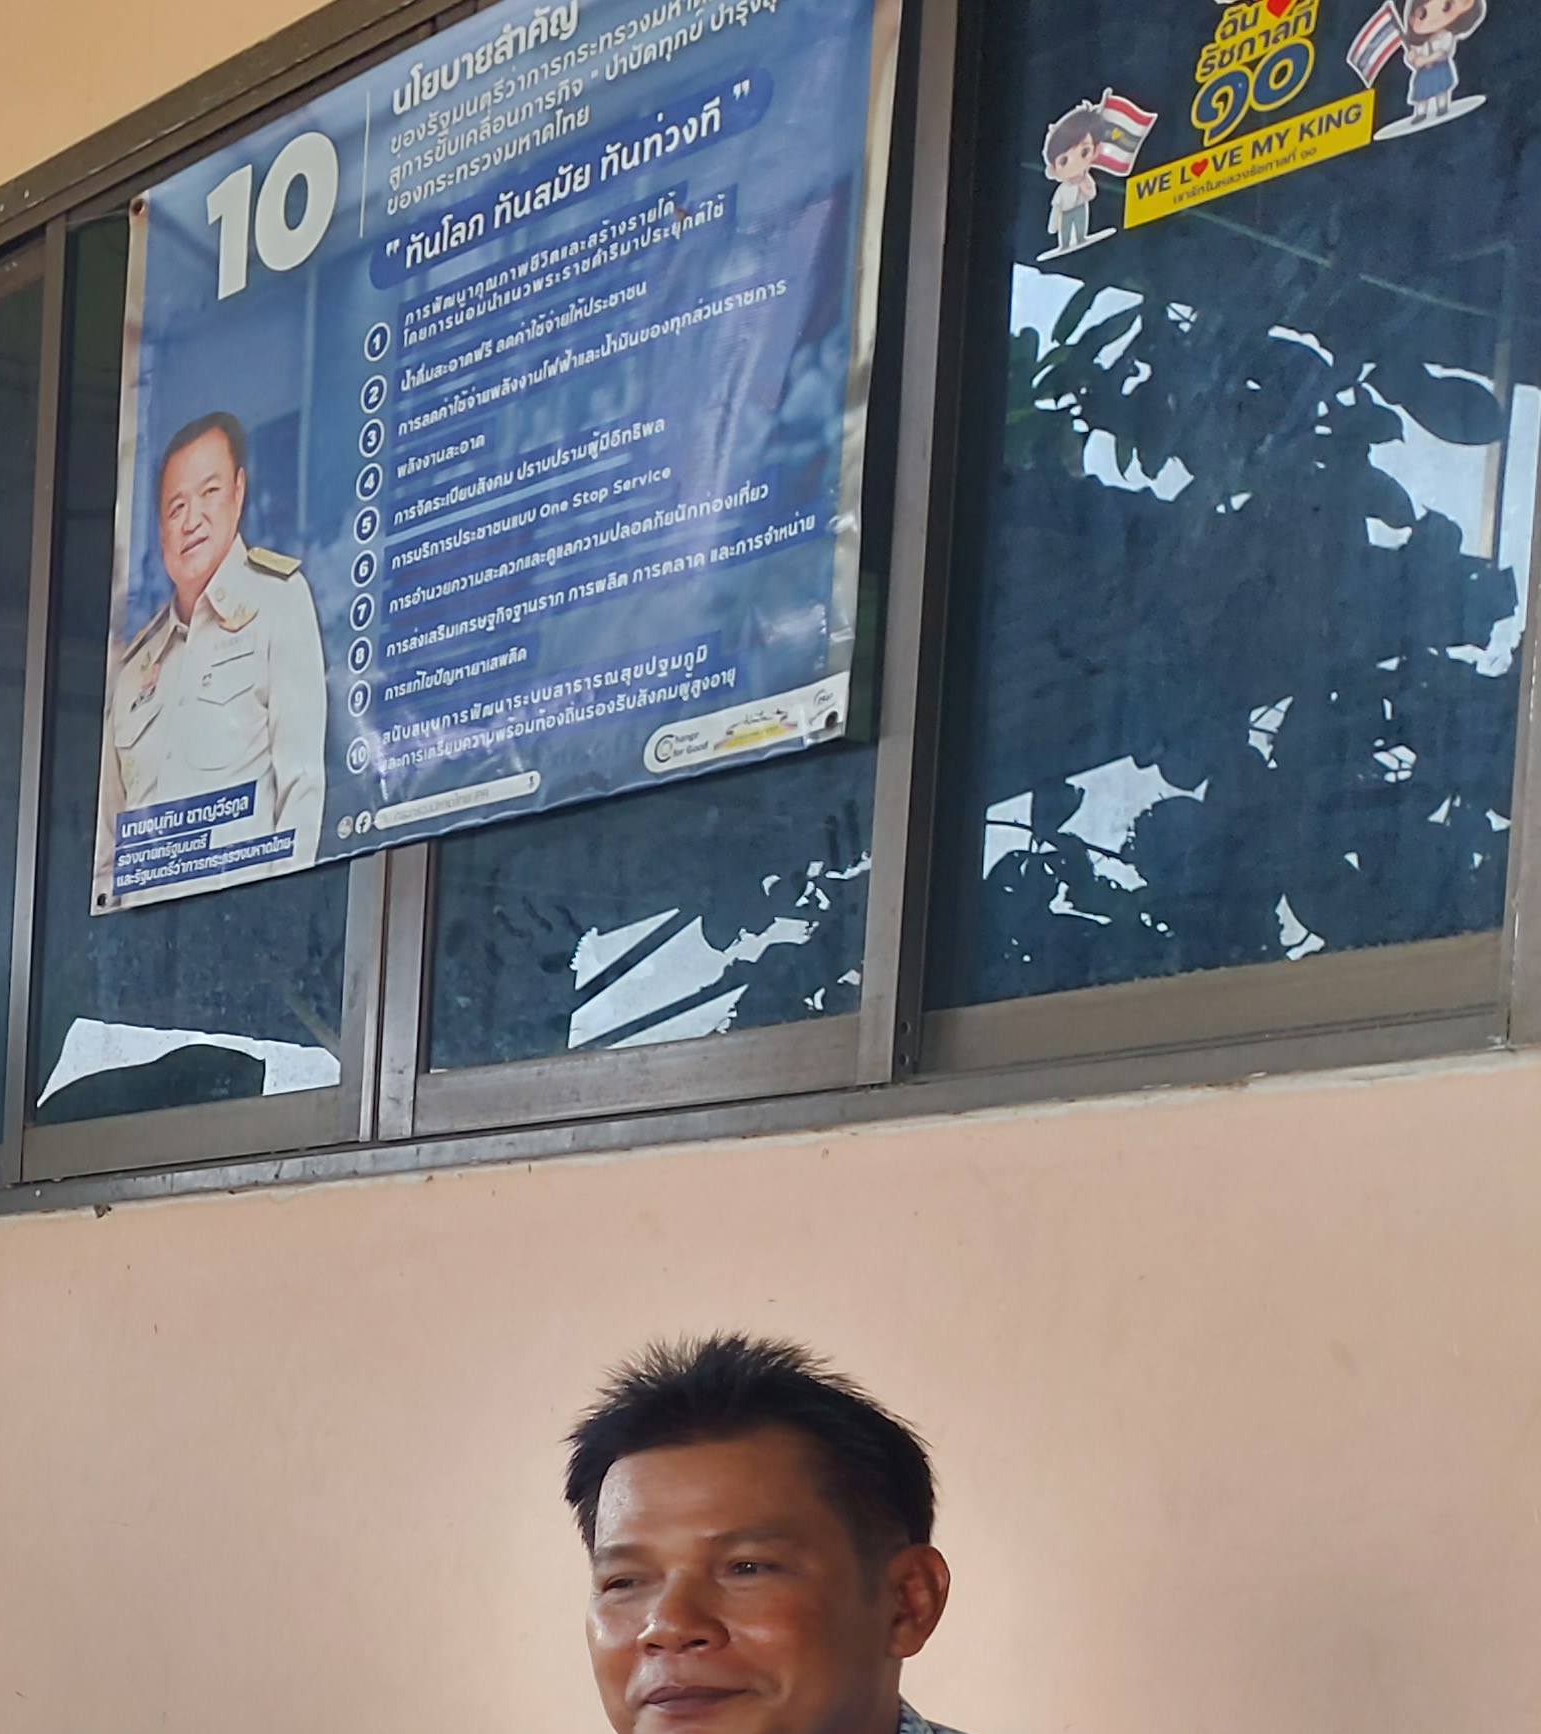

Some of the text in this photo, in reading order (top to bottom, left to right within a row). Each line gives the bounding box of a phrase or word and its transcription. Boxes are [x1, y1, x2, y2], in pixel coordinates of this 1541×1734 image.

[392, 0, 579, 115] นโยบายสำคัญ
[605, 7, 704, 80] บำบัดทุกข์
[1220, 6, 1259, 40] ฉัน
[1196, 41, 1311, 141] ๑๐
[387, 105, 590, 216] ของกระทรวงมหาดไทย
[405, 212, 485, 269] ทันโลก
[494, 162, 591, 229] ทันสมัย
[600, 96, 721, 181] ทันท่วงที
[1136, 173, 1173, 200] WE
[1251, 128, 1290, 160] MY
[1299, 103, 1364, 142] KING
[206, 131, 339, 300] 10
[495, 280, 648, 353] ลดค่าใช้จ่ายให้ประชาชน
[393, 469, 514, 526] การจัดระเบียบสังคม
[516, 417, 666, 481] ปราบปรามผู้มีอิทธิพล
[396, 433, 485, 479] พลังงานสะอาด
[391, 508, 536, 570] การบริการประชาชนแบบ
[539, 500, 569, 518] One
[572, 484, 609, 509] Stop
[613, 466, 672, 494] Service
[386, 591, 564, 657] การส่งเสริมเศรษฐกิจฐานราก
[568, 571, 628, 602] การผลิต
[633, 552, 705, 584] การตลาด
[710, 511, 815, 562] และการจำหน่าย
[351, 746, 366, 765] 10
[686, 741, 710, 756] Good
[118, 833, 208, 867] รองนายกรัฐมนตรี
[121, 795, 249, 839] นายอนุทิน ชาญวีรกูล
